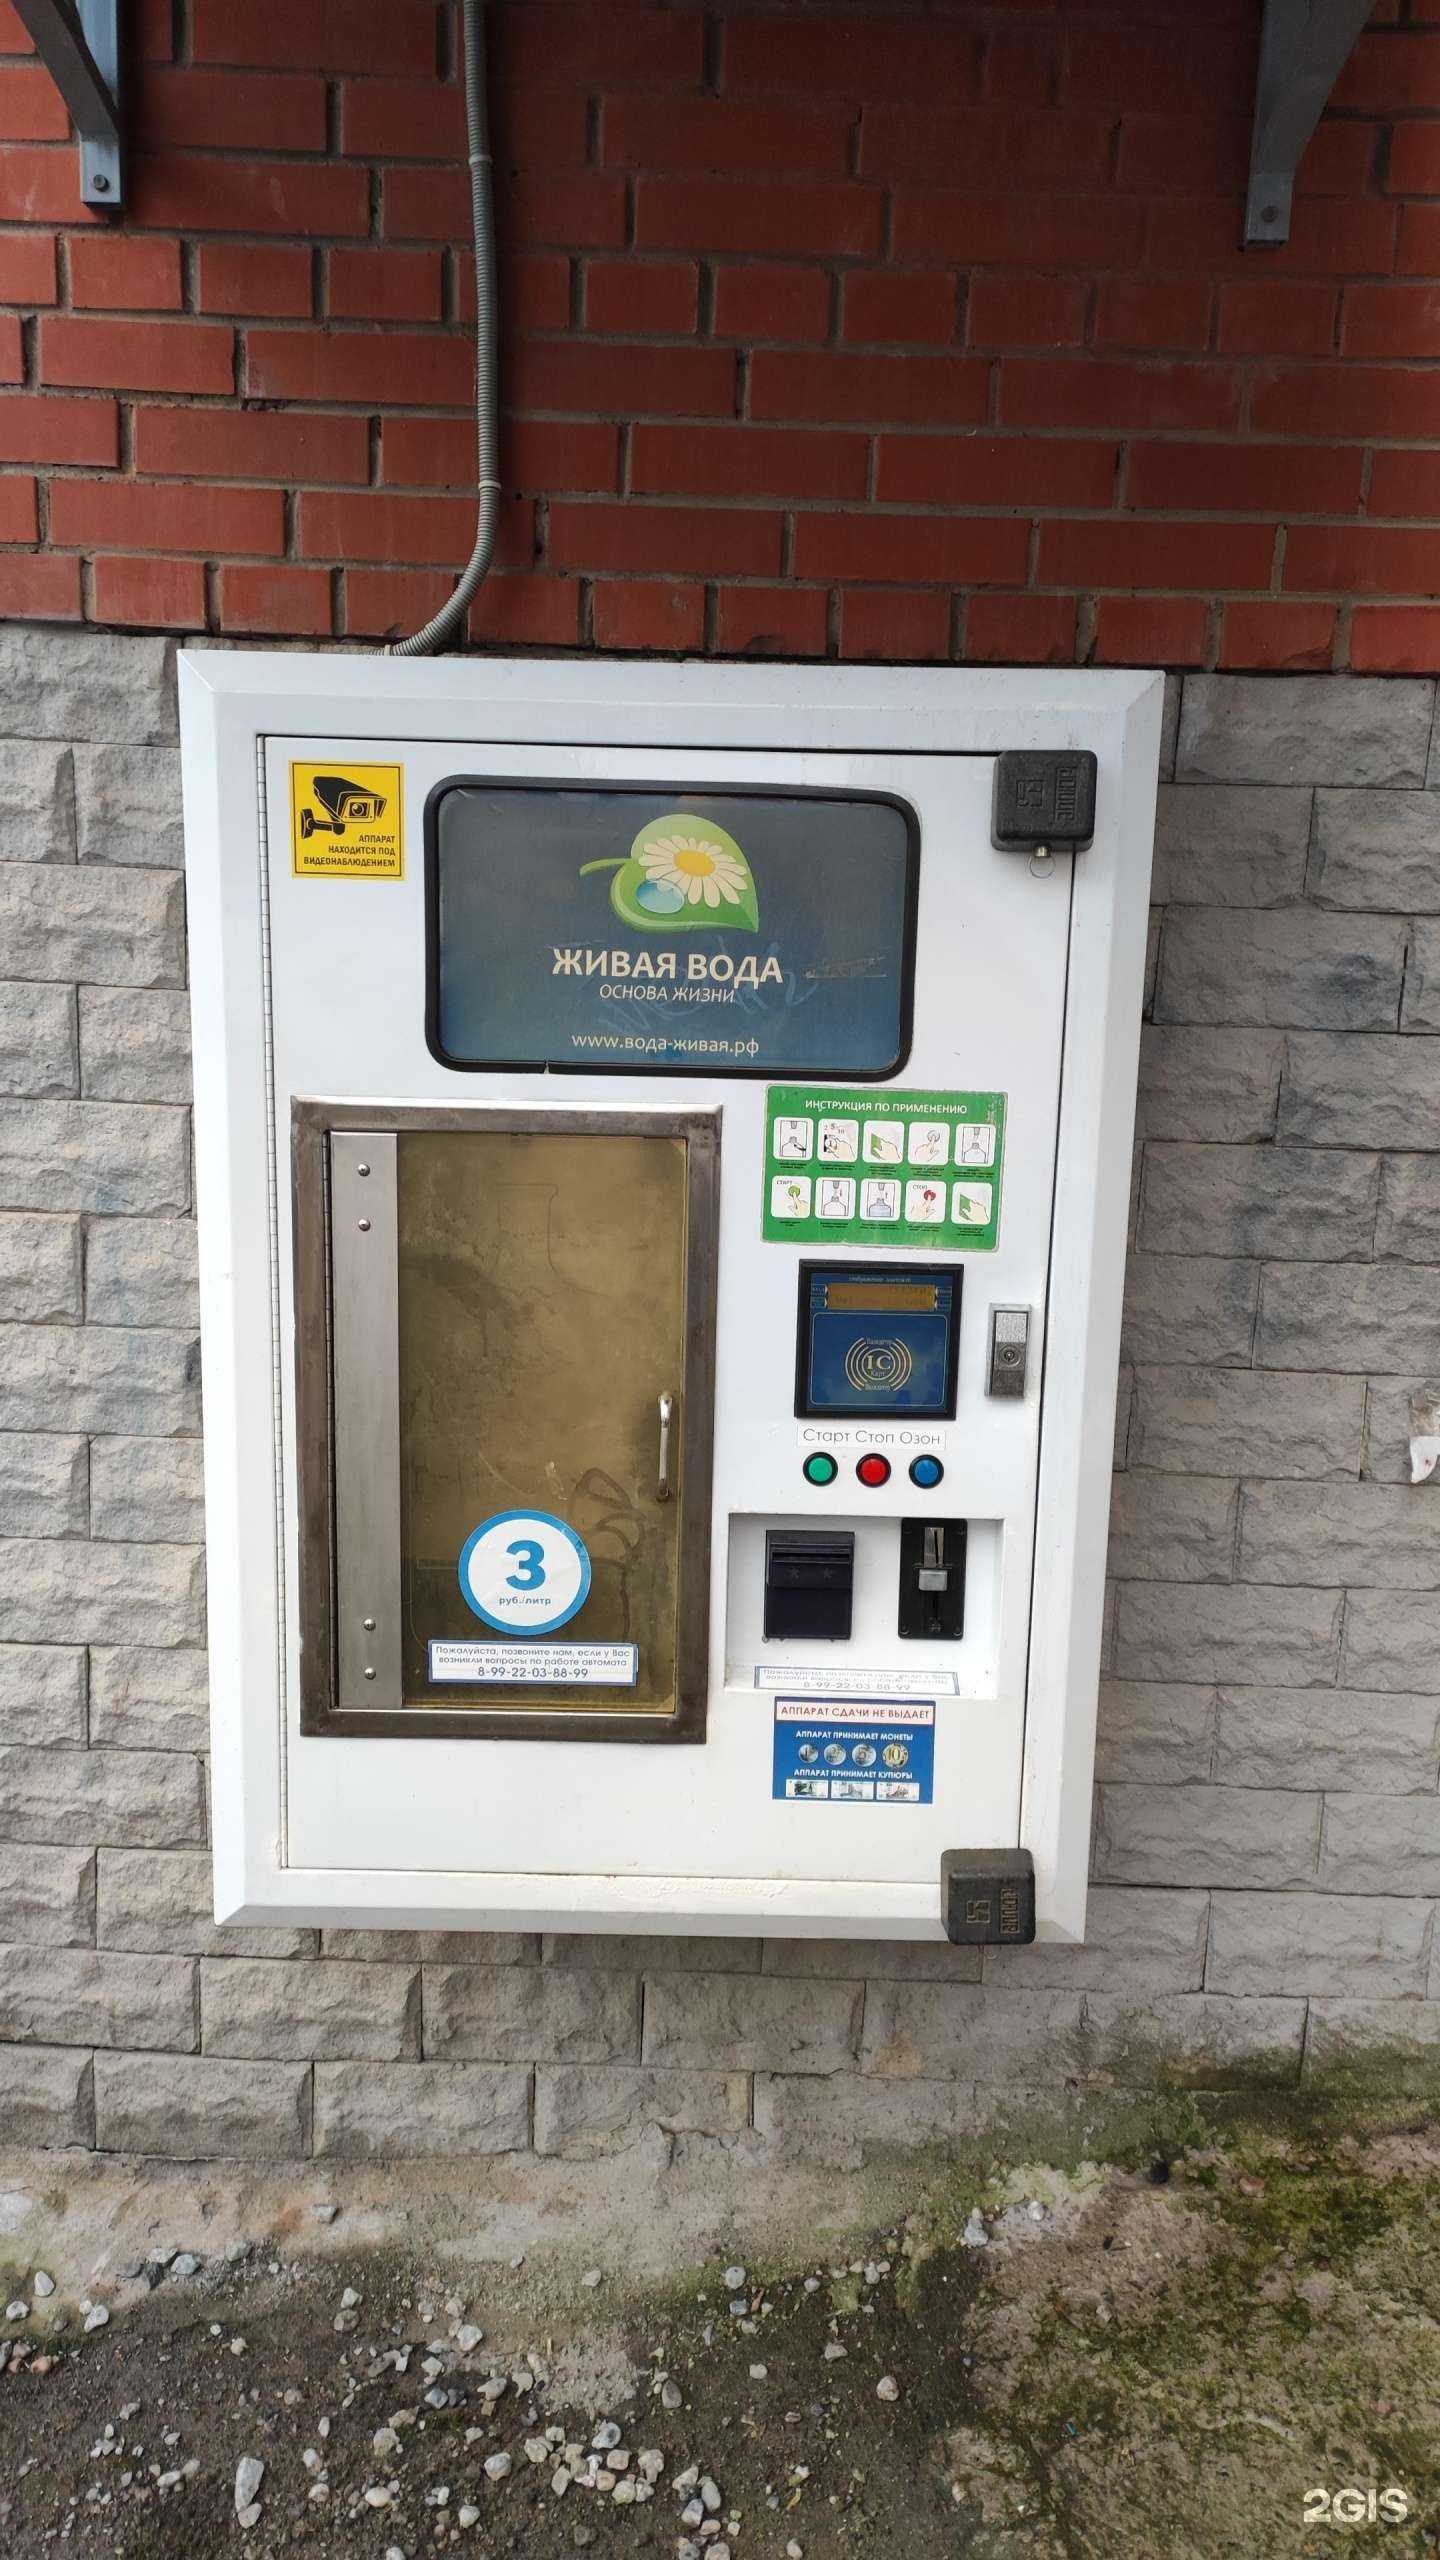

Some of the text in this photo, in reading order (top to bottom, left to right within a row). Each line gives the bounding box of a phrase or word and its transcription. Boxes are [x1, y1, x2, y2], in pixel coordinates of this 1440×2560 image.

[359, 834, 395, 844] АППАРАТ
[328, 845, 396, 856] НАХОДИТСЯ ПОД
[303, 856, 395, 867] ВИДЕОНАБЛЮДЕНИЕМ
[552, 948, 784, 990] ЖИВАЯ ВОДА
[599, 983, 736, 1004] ОСНОВА ЖИЗНИ
[571, 1033, 760, 1058] www.вода-живая.рф
[805, 1100, 968, 1114] ИНСТРУКЦИЯ ПО ПРИМЕНЕНИЮ
[803, 1428, 940, 1446] Старт Стоп Озон
[505, 1540, 546, 1591] 3
[499, 1595, 552, 1606] руб./литр
[436, 1646, 498, 1656] Пожалуйста,
[604, 1650, 609, 1658] у
[612, 1649, 630, 1657] Вас
[544, 1658, 579, 1667] работе
[478, 1666, 588, 1679] 8-99-22-03-88-99
[780, 1706, 929, 1720] АППАРАТ СДАЧИ НЕ ВЫДАЕТ
[795, 1730, 914, 1741] АППАРАТ ПРИНИМАЕТ МОНЕТЫ
[794, 1769, 913, 1780] АППАРАТ ПРИНИМАЕТ КУПЮРЫ
